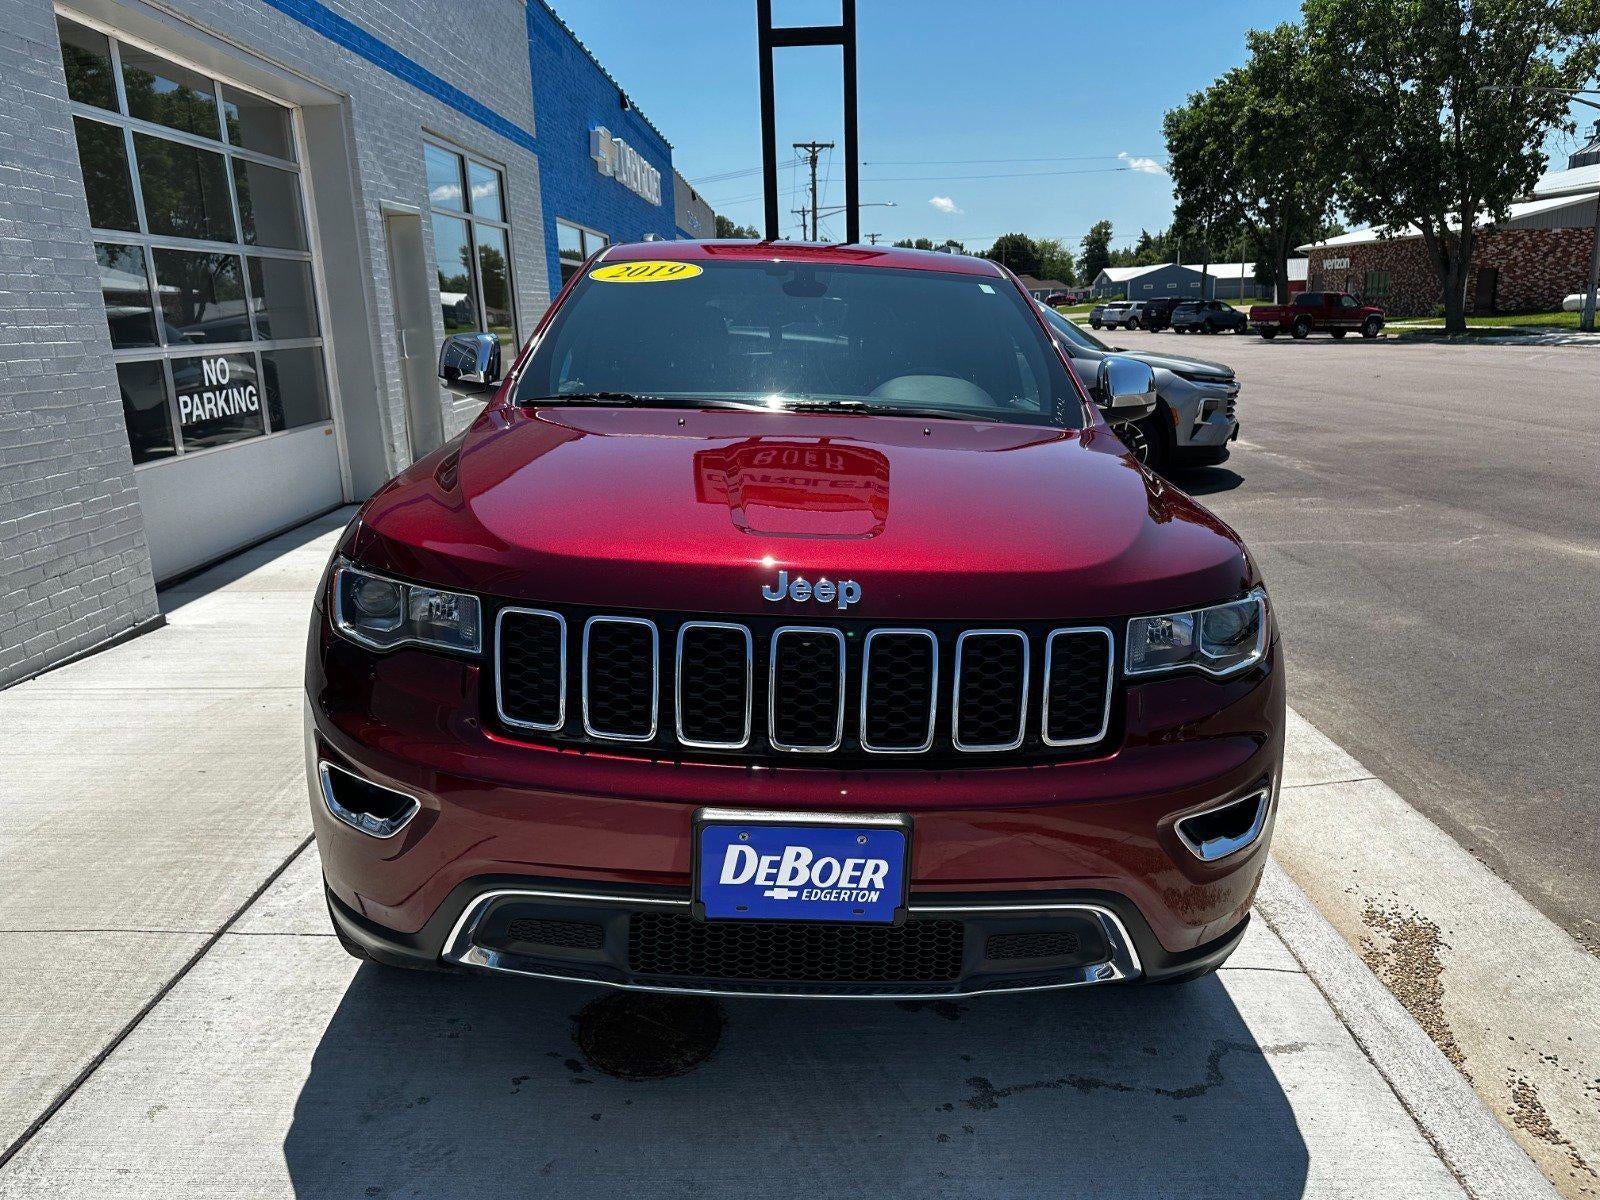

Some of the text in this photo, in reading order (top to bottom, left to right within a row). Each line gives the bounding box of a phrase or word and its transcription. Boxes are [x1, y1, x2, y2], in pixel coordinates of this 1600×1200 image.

[606, 264, 687, 279] 2019
[1323, 256, 1350, 270] verizon
[202, 357, 230, 387] NO
[178, 385, 259, 424] PARKING
[762, 570, 862, 610] Jeep
[801, 888, 880, 903] EDGERTON
